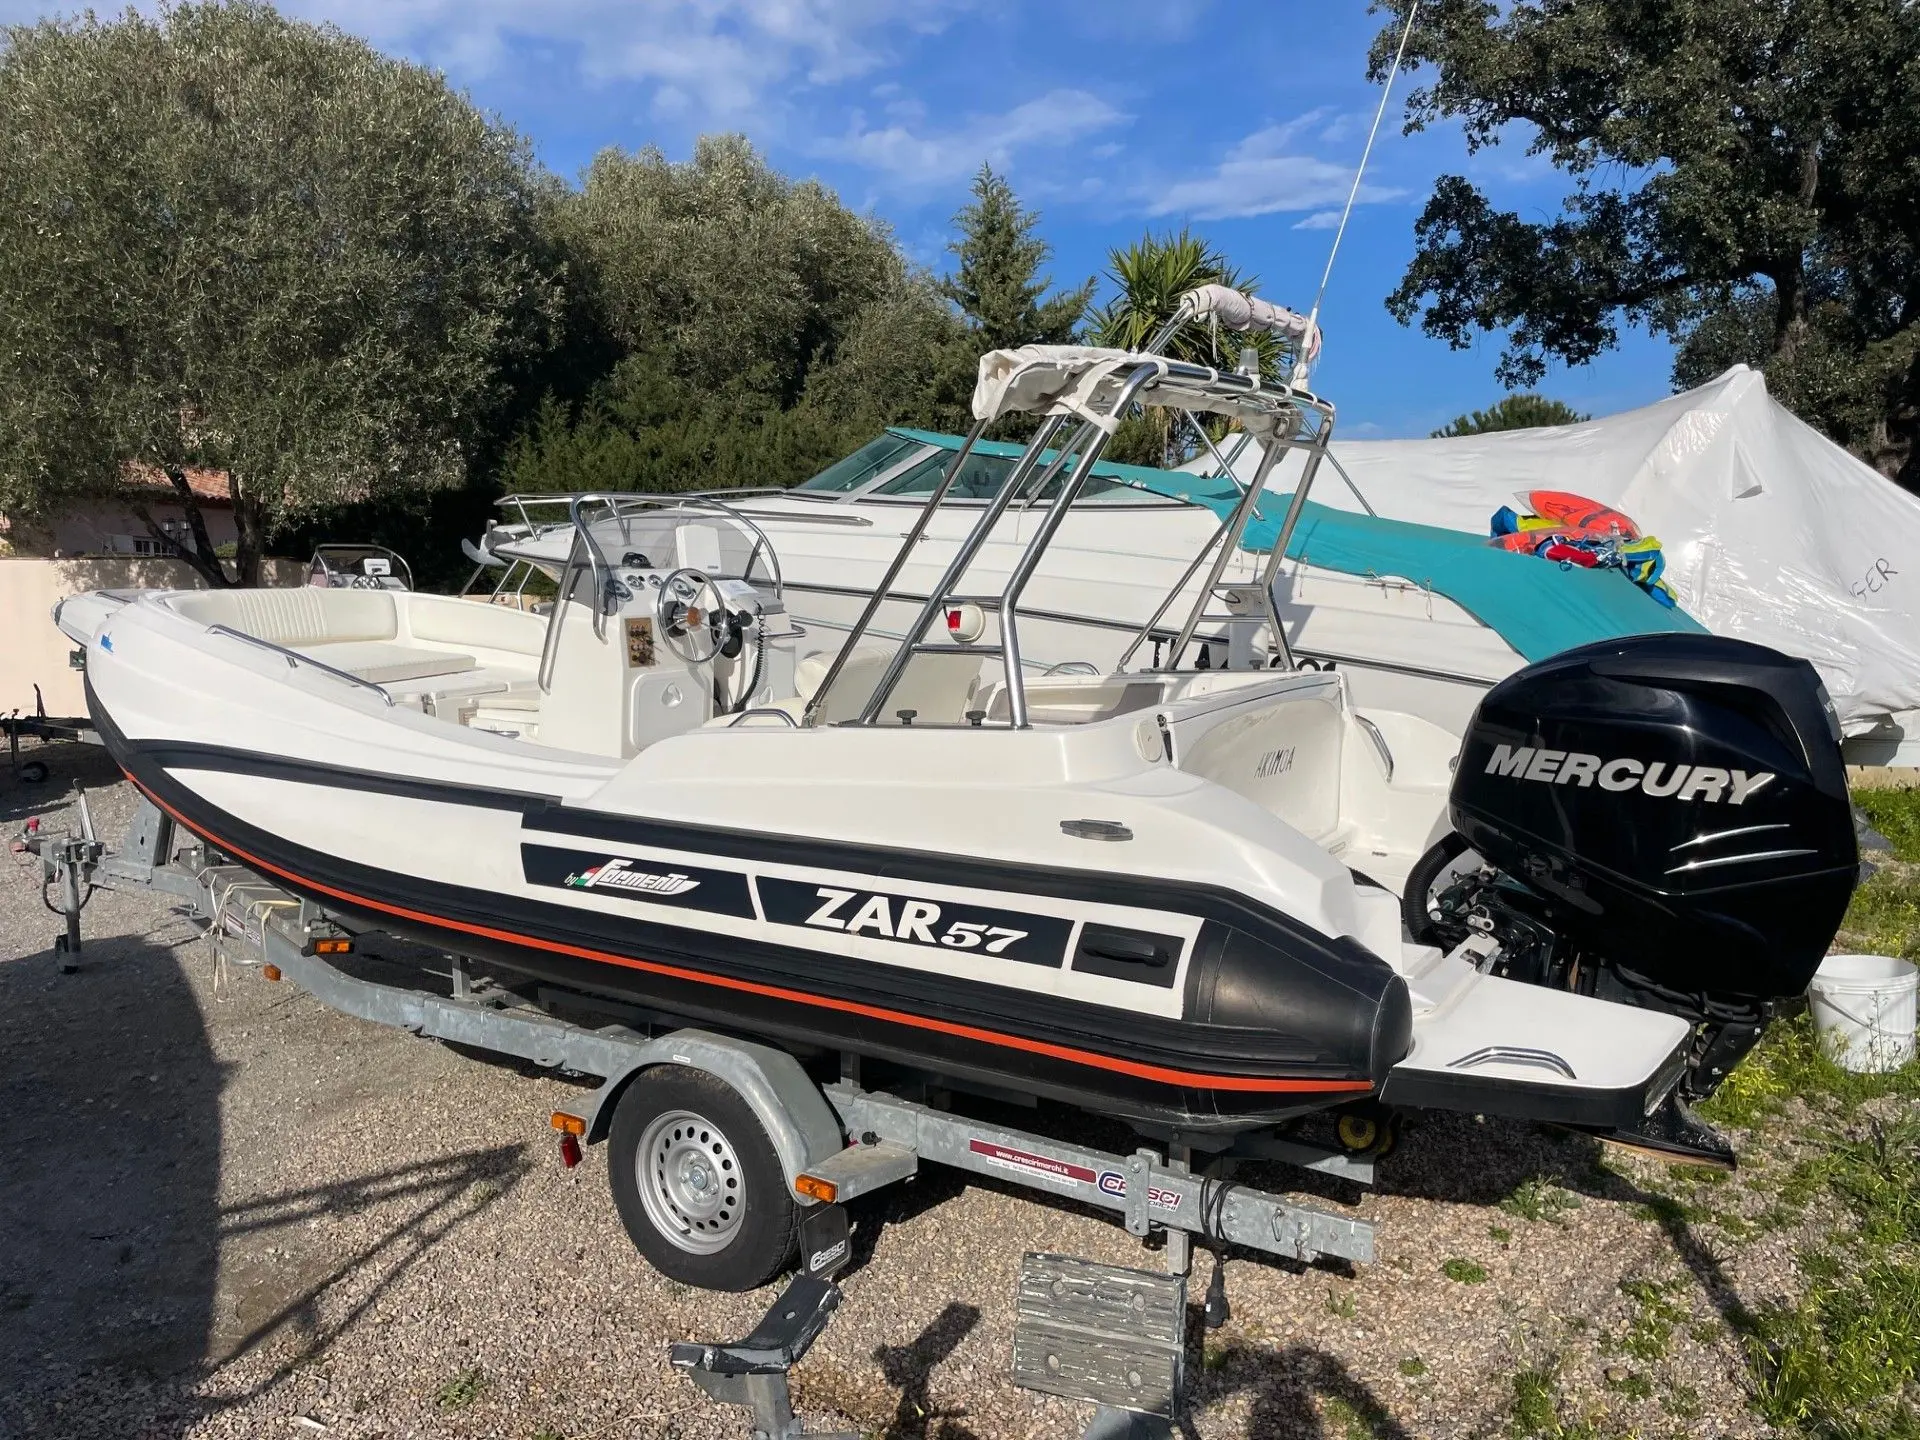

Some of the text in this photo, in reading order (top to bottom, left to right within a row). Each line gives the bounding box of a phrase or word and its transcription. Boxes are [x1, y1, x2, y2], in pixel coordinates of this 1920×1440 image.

[1484, 744, 1776, 805] MERCURY
[804, 887, 1029, 953] ZAR 57
[995, 1150, 1069, 1175] www.crescirimorchi.it
[1099, 1171, 1181, 1206] CRSCI
